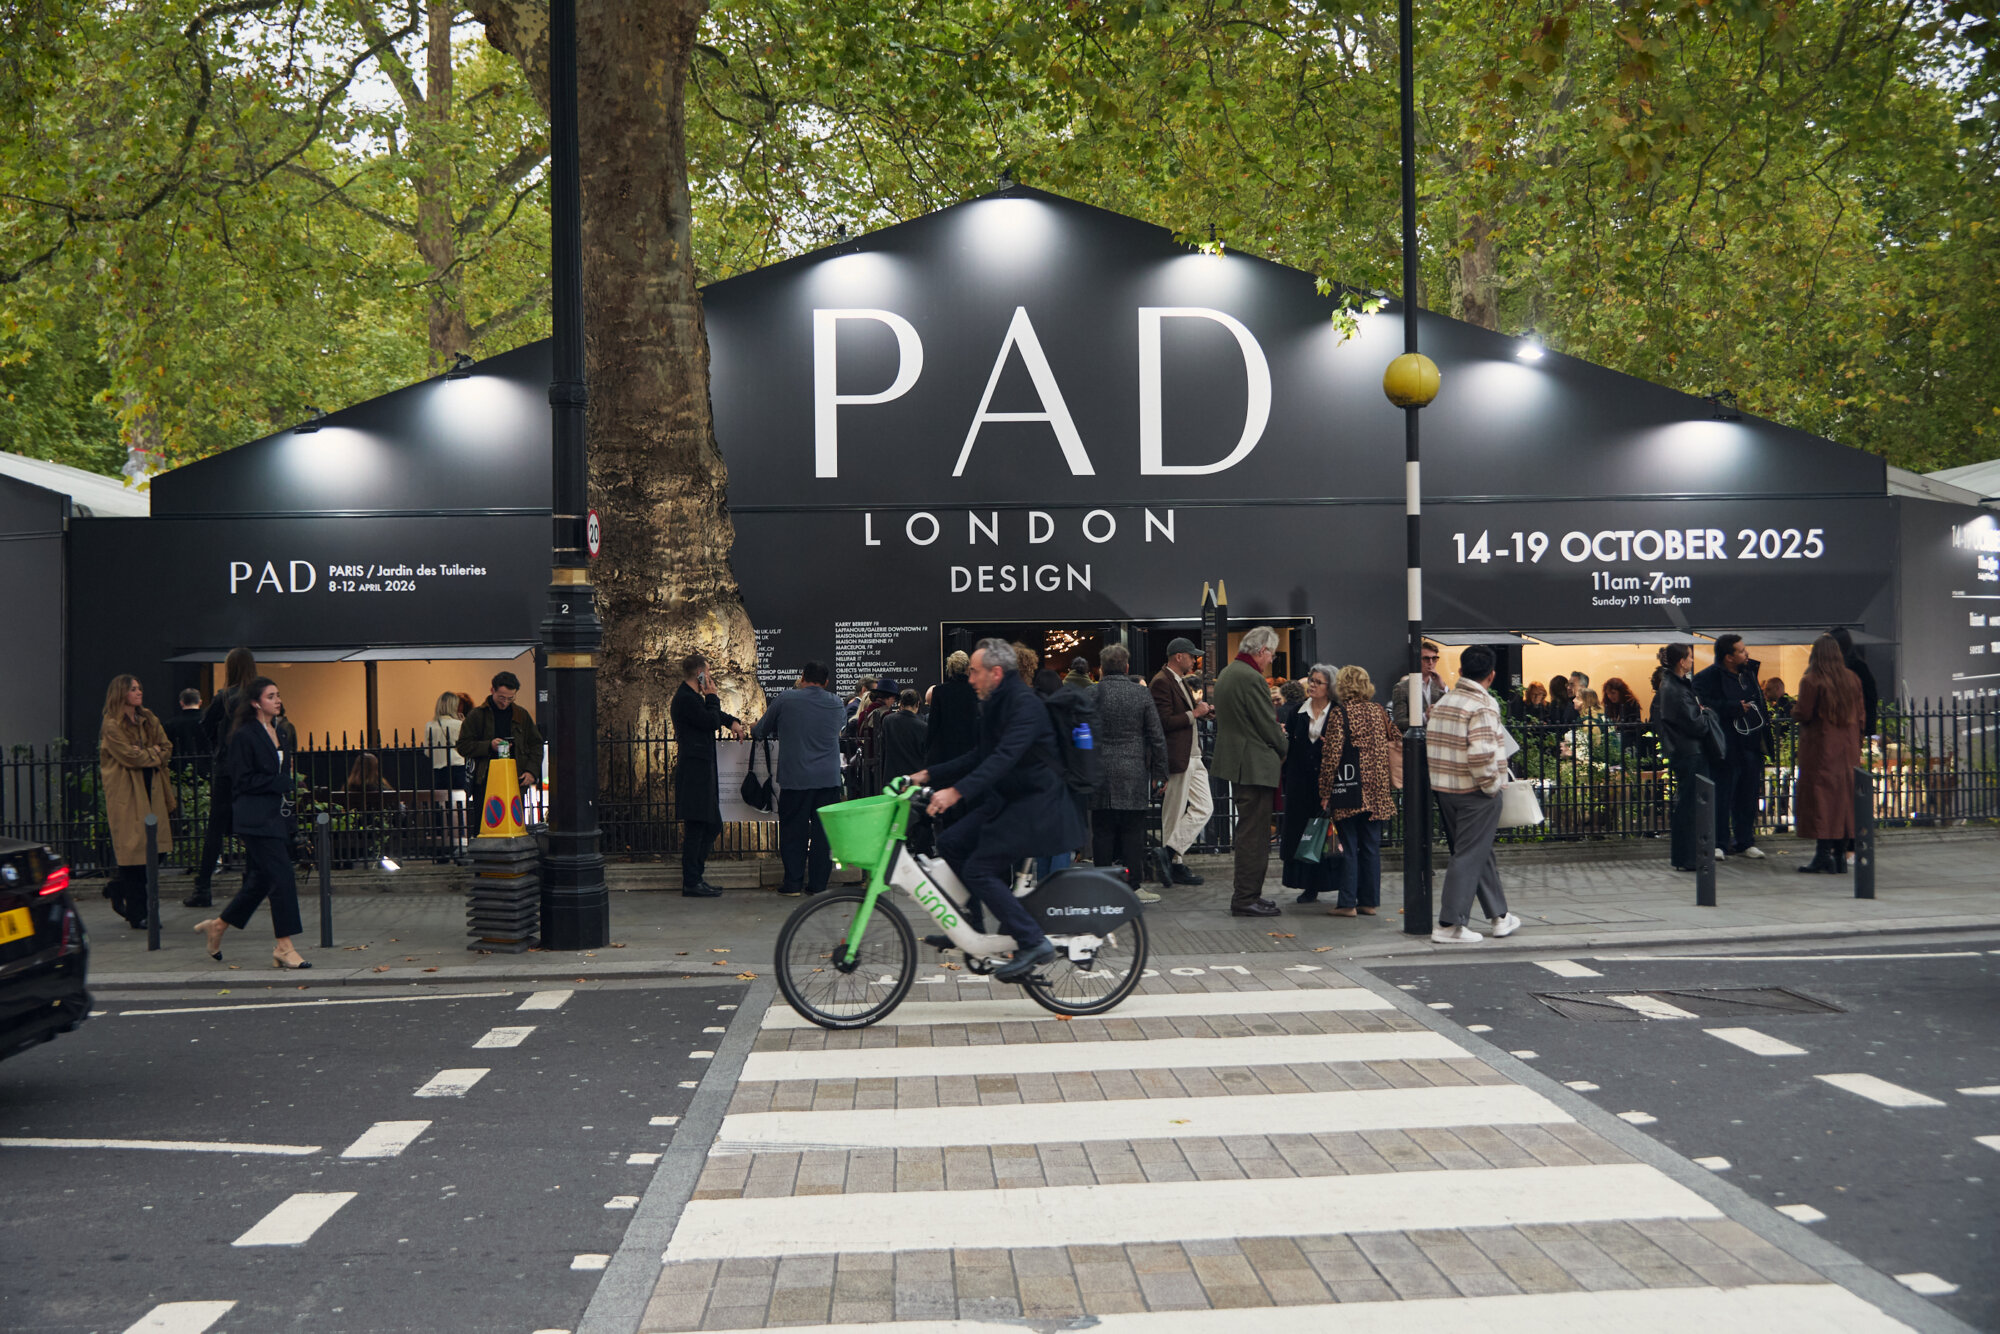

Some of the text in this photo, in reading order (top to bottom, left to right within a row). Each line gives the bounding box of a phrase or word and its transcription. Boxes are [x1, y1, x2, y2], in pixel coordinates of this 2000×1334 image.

[813, 306, 1272, 478] PAD
[589, 524, 599, 543] 20
[864, 507, 1175, 547] LONDON
[1452, 528, 1824, 564] 14-19 OCTOBER 2025
[230, 560, 317, 594] PAD
[329, 565, 364, 577] PARIS
[377, 564, 413, 577] Jardin
[416, 564, 437, 576] des
[440, 564, 487, 576] Tuileries
[950, 562, 1092, 593] DESIGN
[329, 580, 416, 592] 8-12 APRIL 2026
[1591, 571, 1691, 595] 11am -7pm
[561, 604, 569, 614] 2
[1592, 594, 1691, 608] Sunday 19 11am-6pm
[914, 880, 958, 930] Lime
[1046, 906, 1064, 916] On
[1064, 905, 1090, 916] Lime
[1100, 904, 1125, 915] Uber
